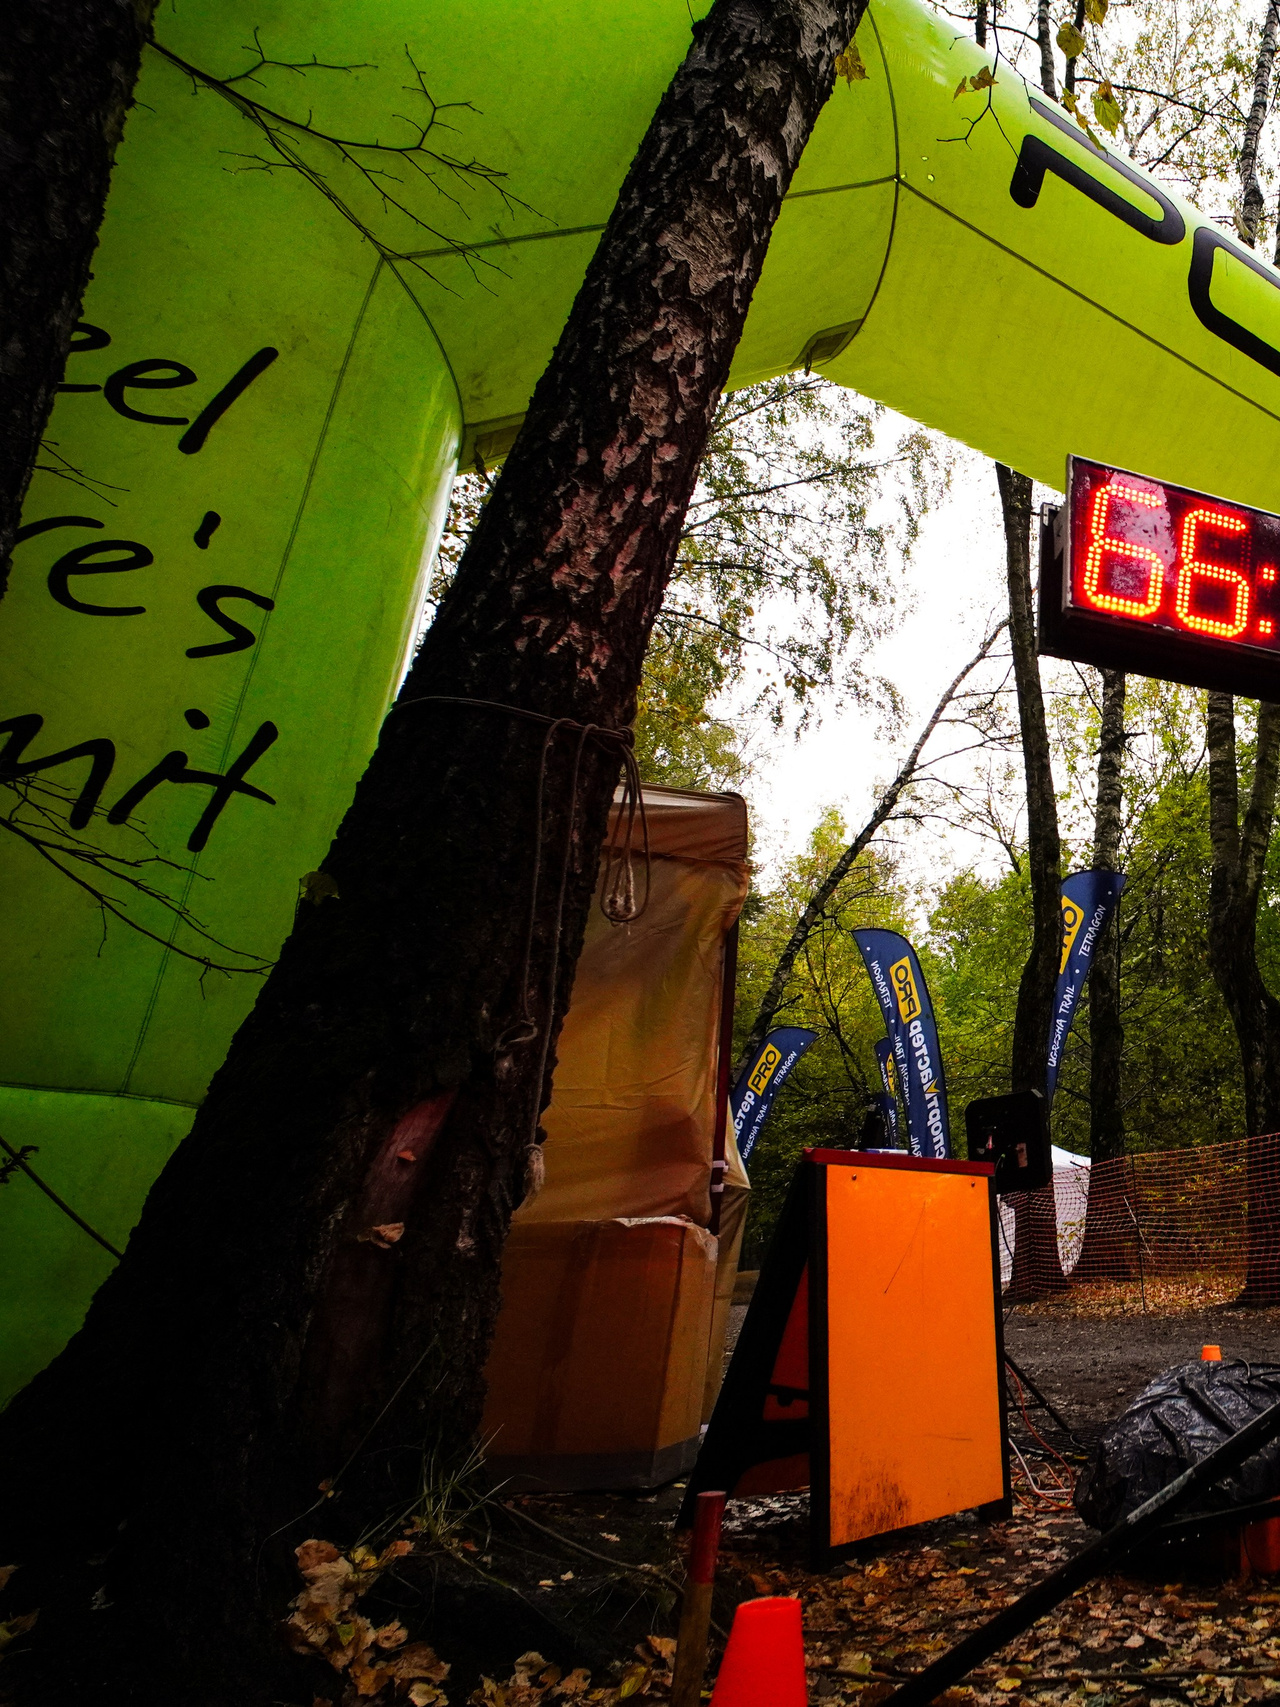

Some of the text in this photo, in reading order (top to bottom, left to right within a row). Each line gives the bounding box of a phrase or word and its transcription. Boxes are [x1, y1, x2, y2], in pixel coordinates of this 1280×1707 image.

[1047, 904, 1107, 1068] UGRESHA TRAIL TETRAGON
[742, 1051, 798, 1159] UGRESHA TRAIL TETRAGON
[751, 1050, 777, 1091] PRO
